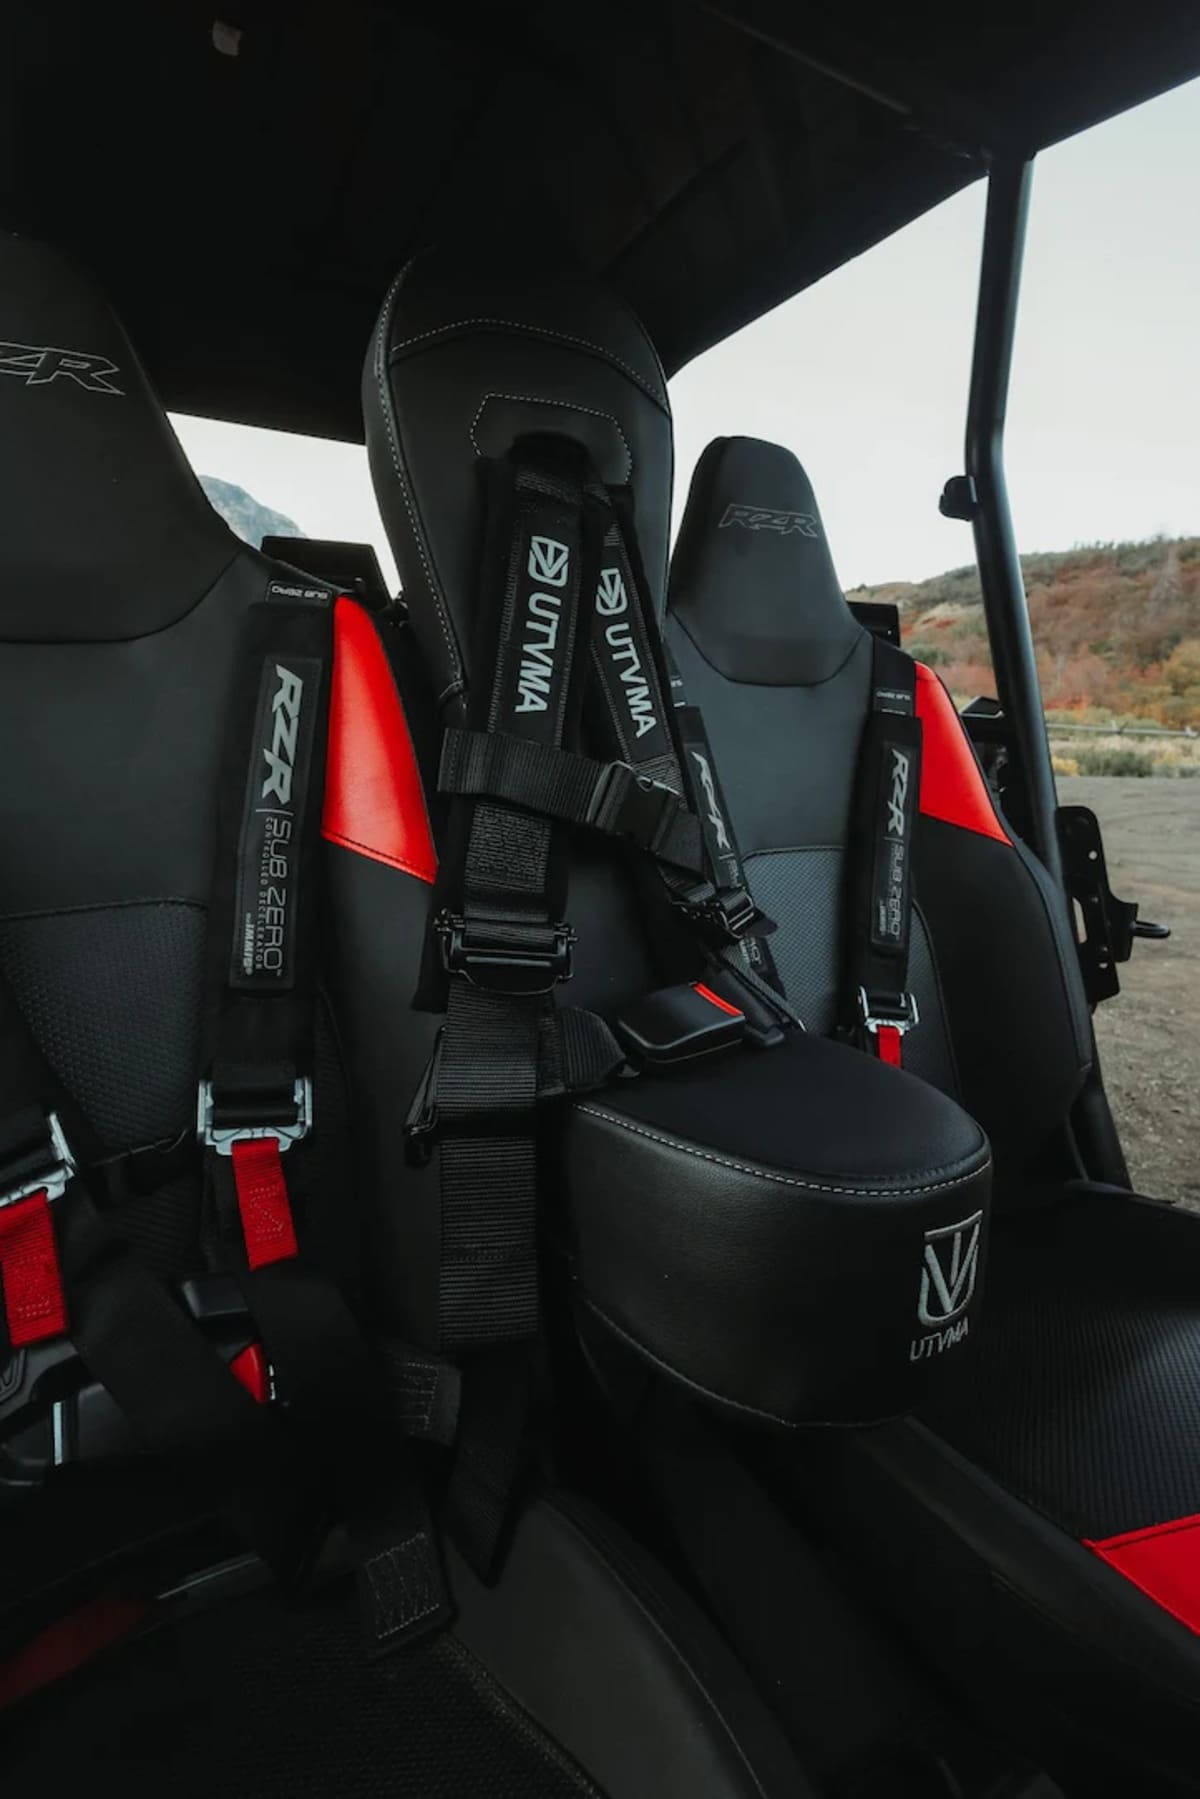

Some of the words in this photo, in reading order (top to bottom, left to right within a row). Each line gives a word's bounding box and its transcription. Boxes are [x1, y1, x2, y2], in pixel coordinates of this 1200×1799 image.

[718, 503, 819, 538] RZR
[514, 592, 562, 713] UTVMA
[604, 622, 657, 738] UTVMA
[262, 663, 304, 805] RZR
[887, 748, 909, 836] RZR
[268, 818, 293, 879] SUB
[263, 886, 287, 970] ZERO
[909, 1316, 969, 1361] UTVMA
